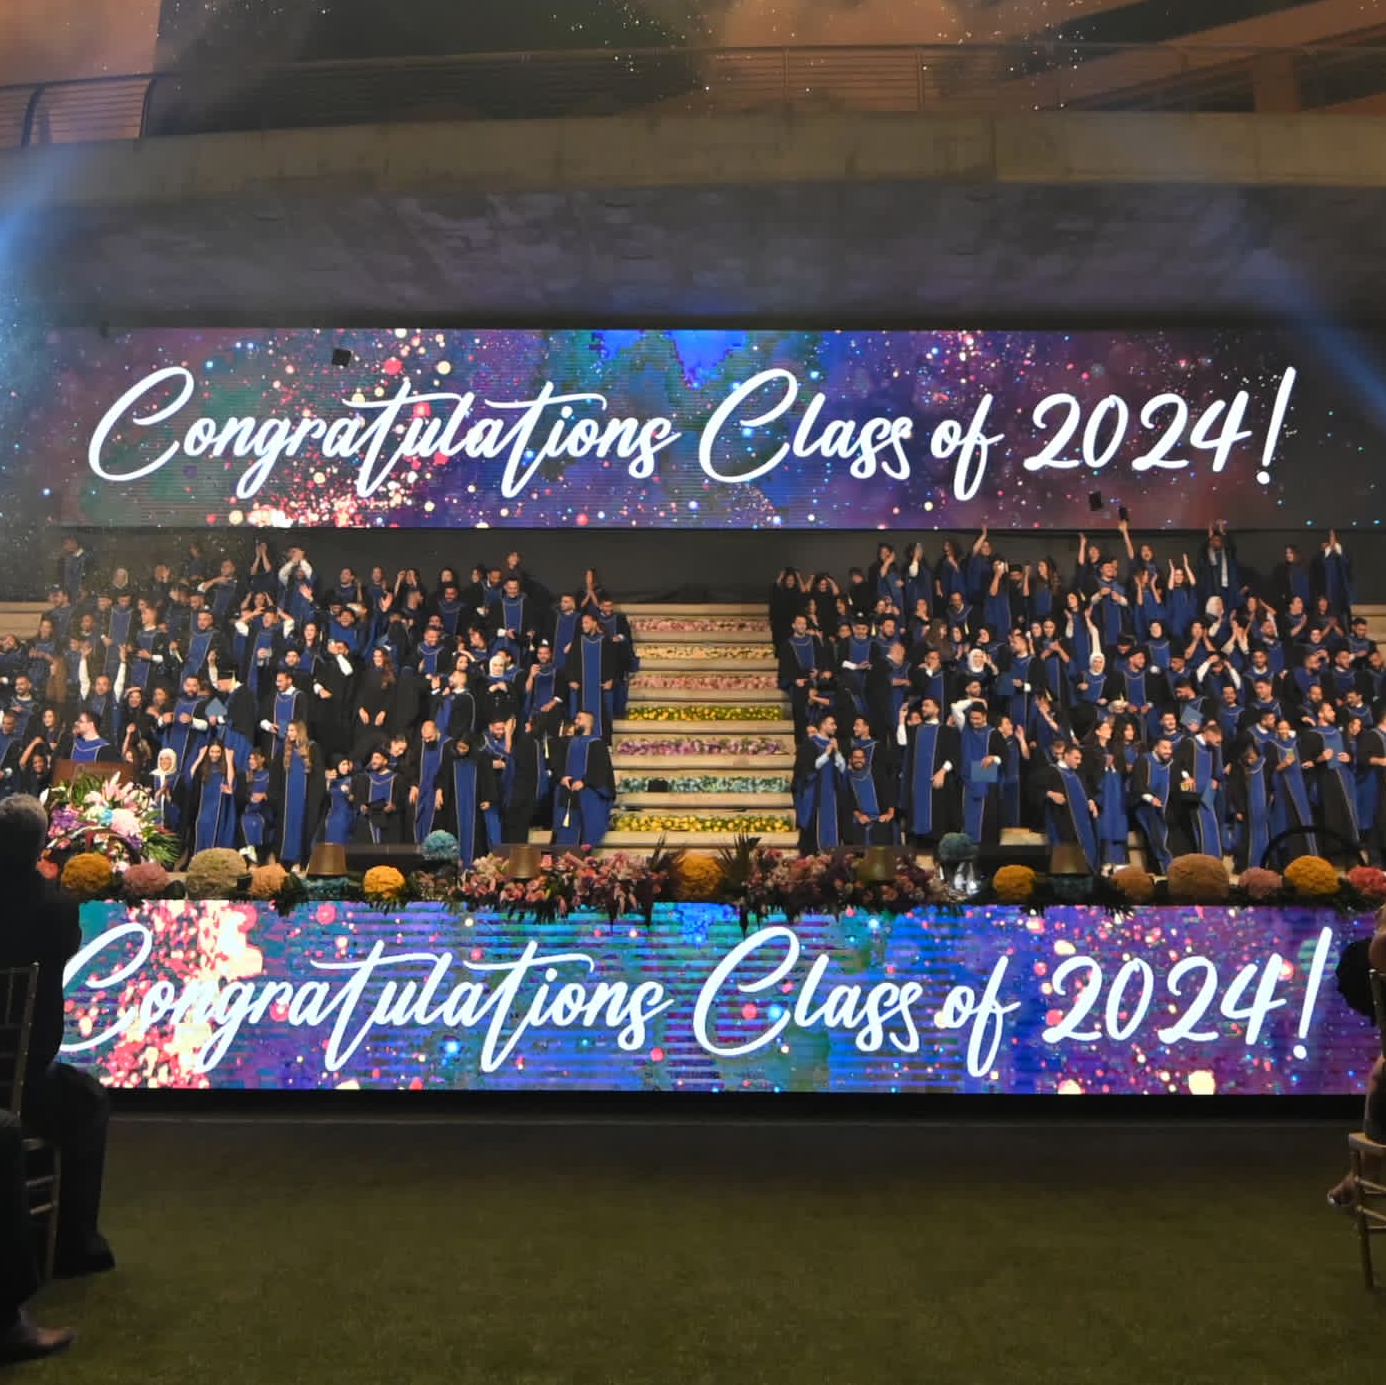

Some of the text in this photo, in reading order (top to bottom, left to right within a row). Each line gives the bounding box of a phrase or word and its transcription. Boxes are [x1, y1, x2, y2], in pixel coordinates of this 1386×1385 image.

[88, 366, 1297, 501] Congratulations Class of 2024!
[59, 923, 1333, 1078] Congratulations Class of 2024!
